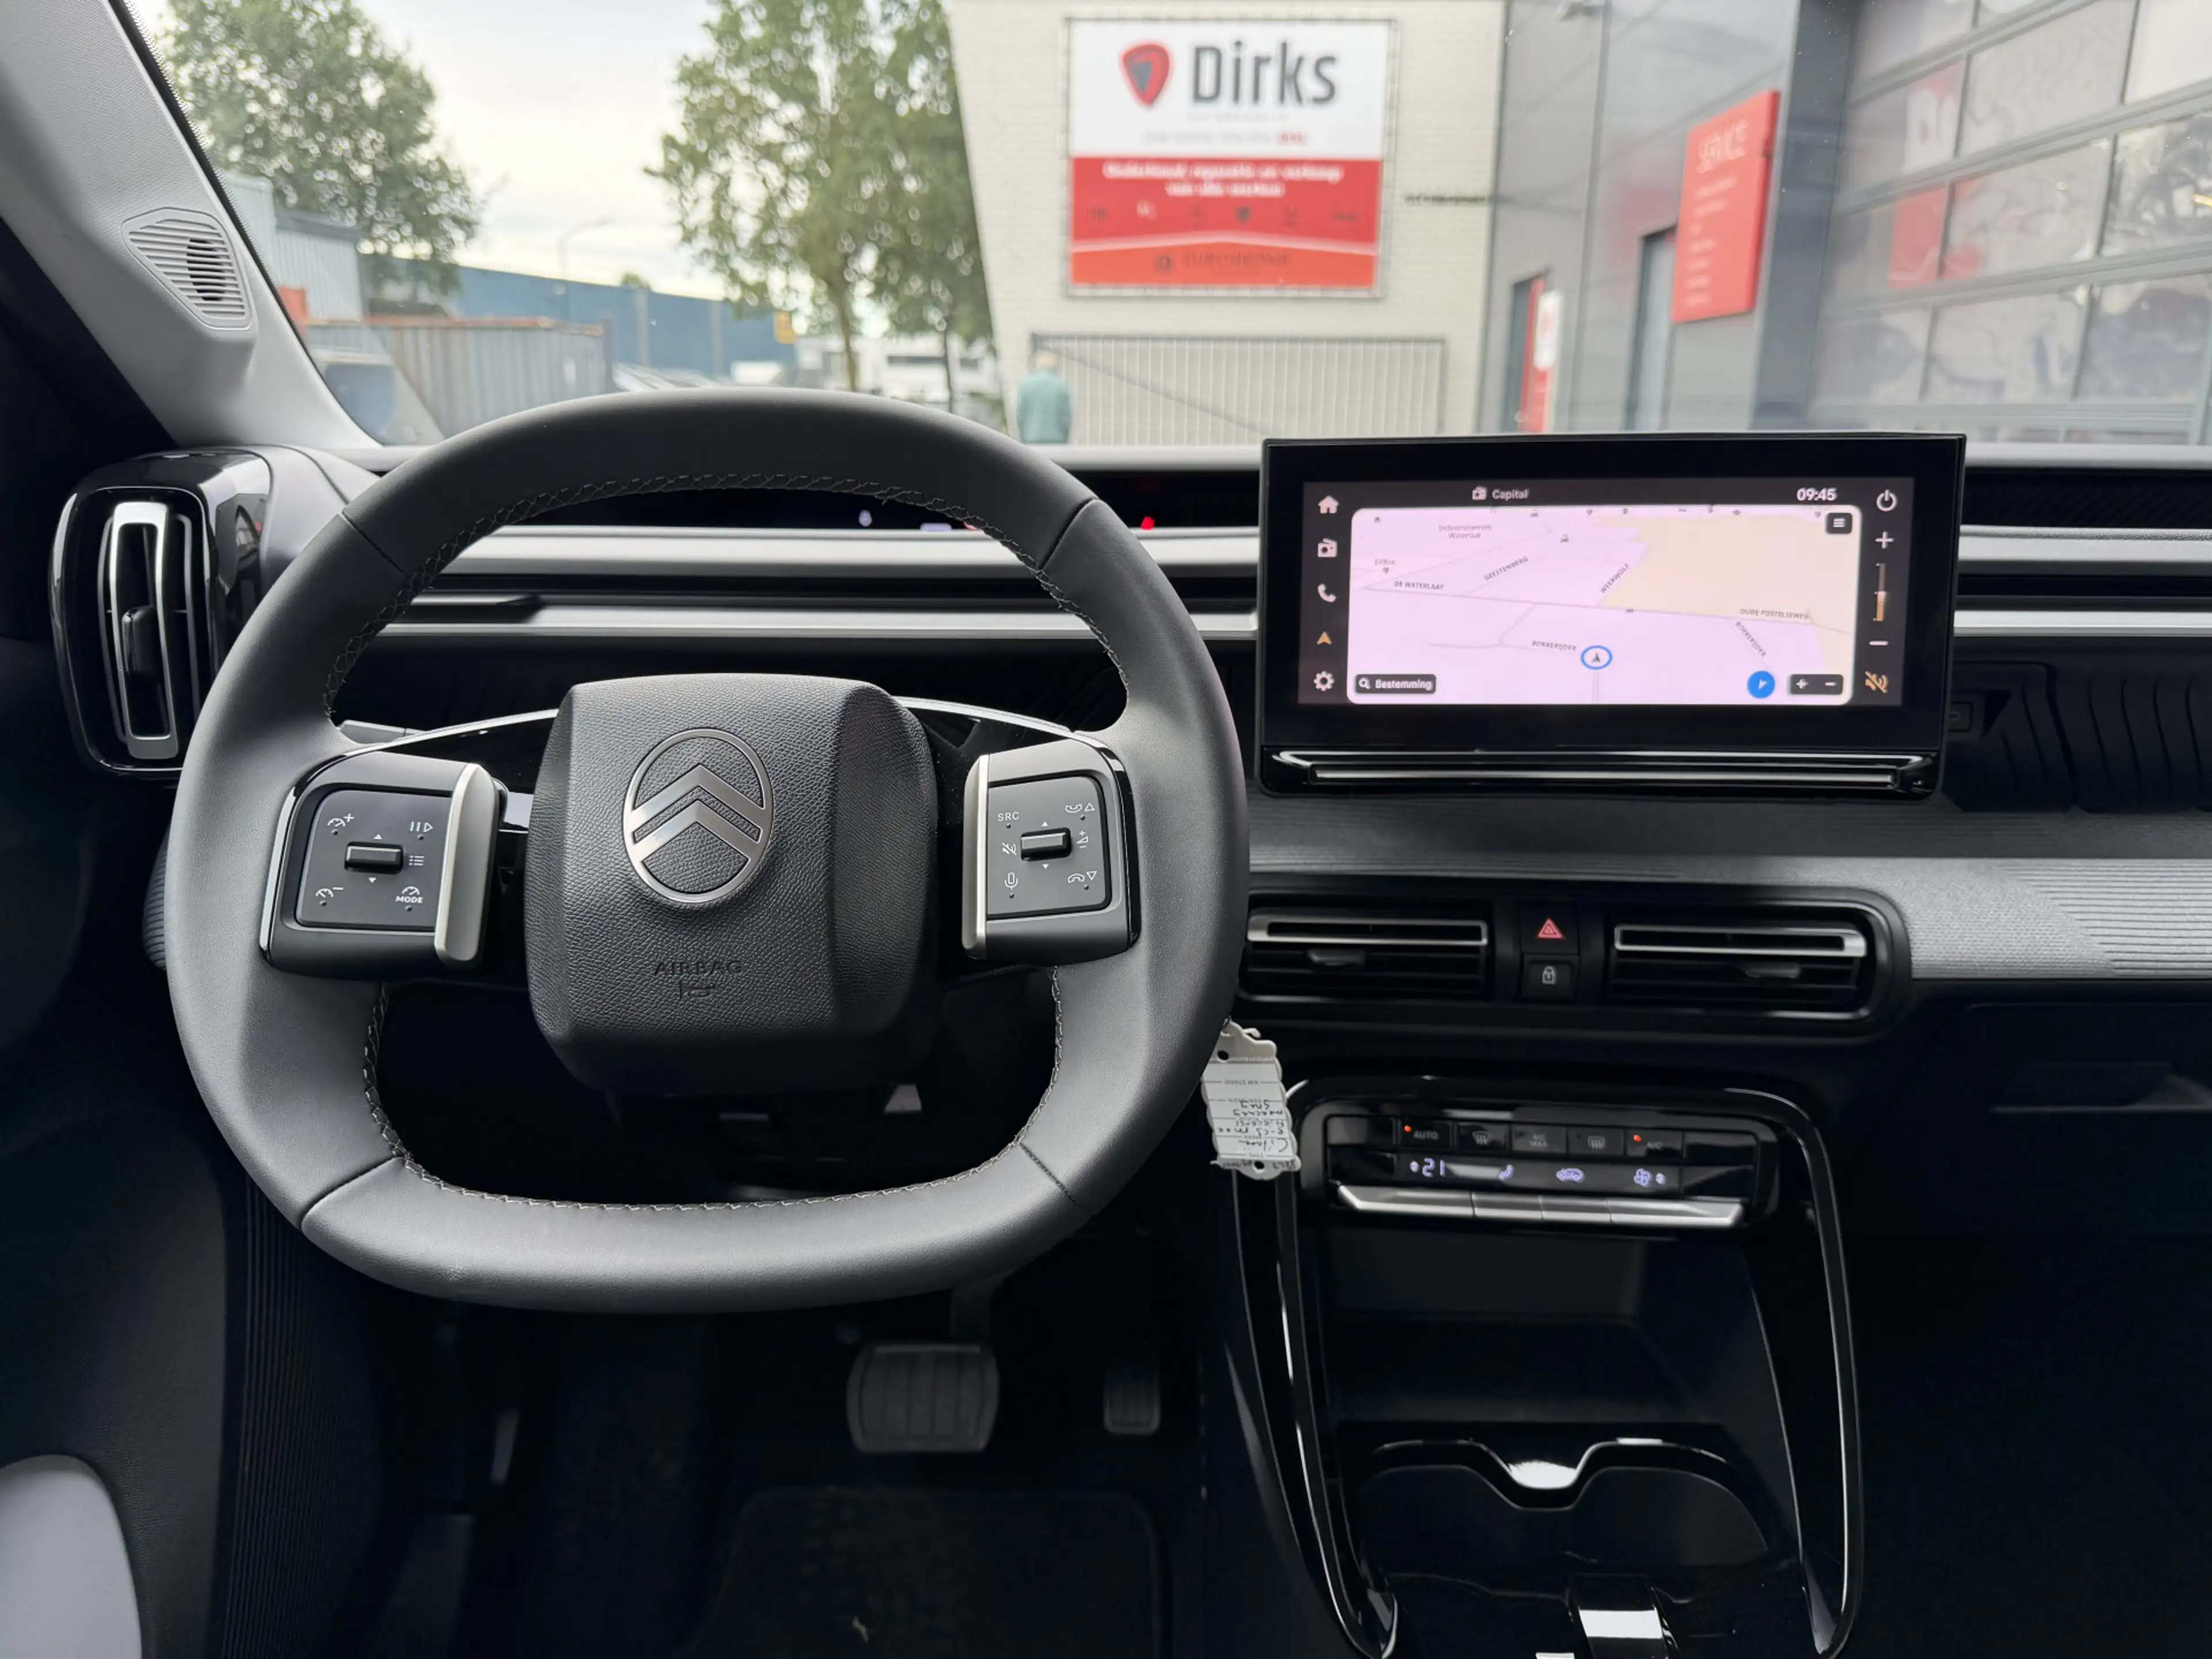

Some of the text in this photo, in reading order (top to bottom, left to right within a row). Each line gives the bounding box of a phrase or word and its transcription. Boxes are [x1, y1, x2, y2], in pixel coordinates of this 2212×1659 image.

[1192, 39, 1335, 106] Dirks
[1492, 488, 1529, 501] Capital
[1797, 487, 1837, 501] 09:45
[1404, 582, 1445, 590] WATERLAAT
[1375, 679, 1433, 691] Bestemming
[997, 811, 1020, 821] SRC
[395, 895, 423, 903] MODE
[654, 960, 743, 976] AIRBAG
[1413, 1130, 1439, 1140] AUTO
[1422, 1158, 1446, 1177] 21
